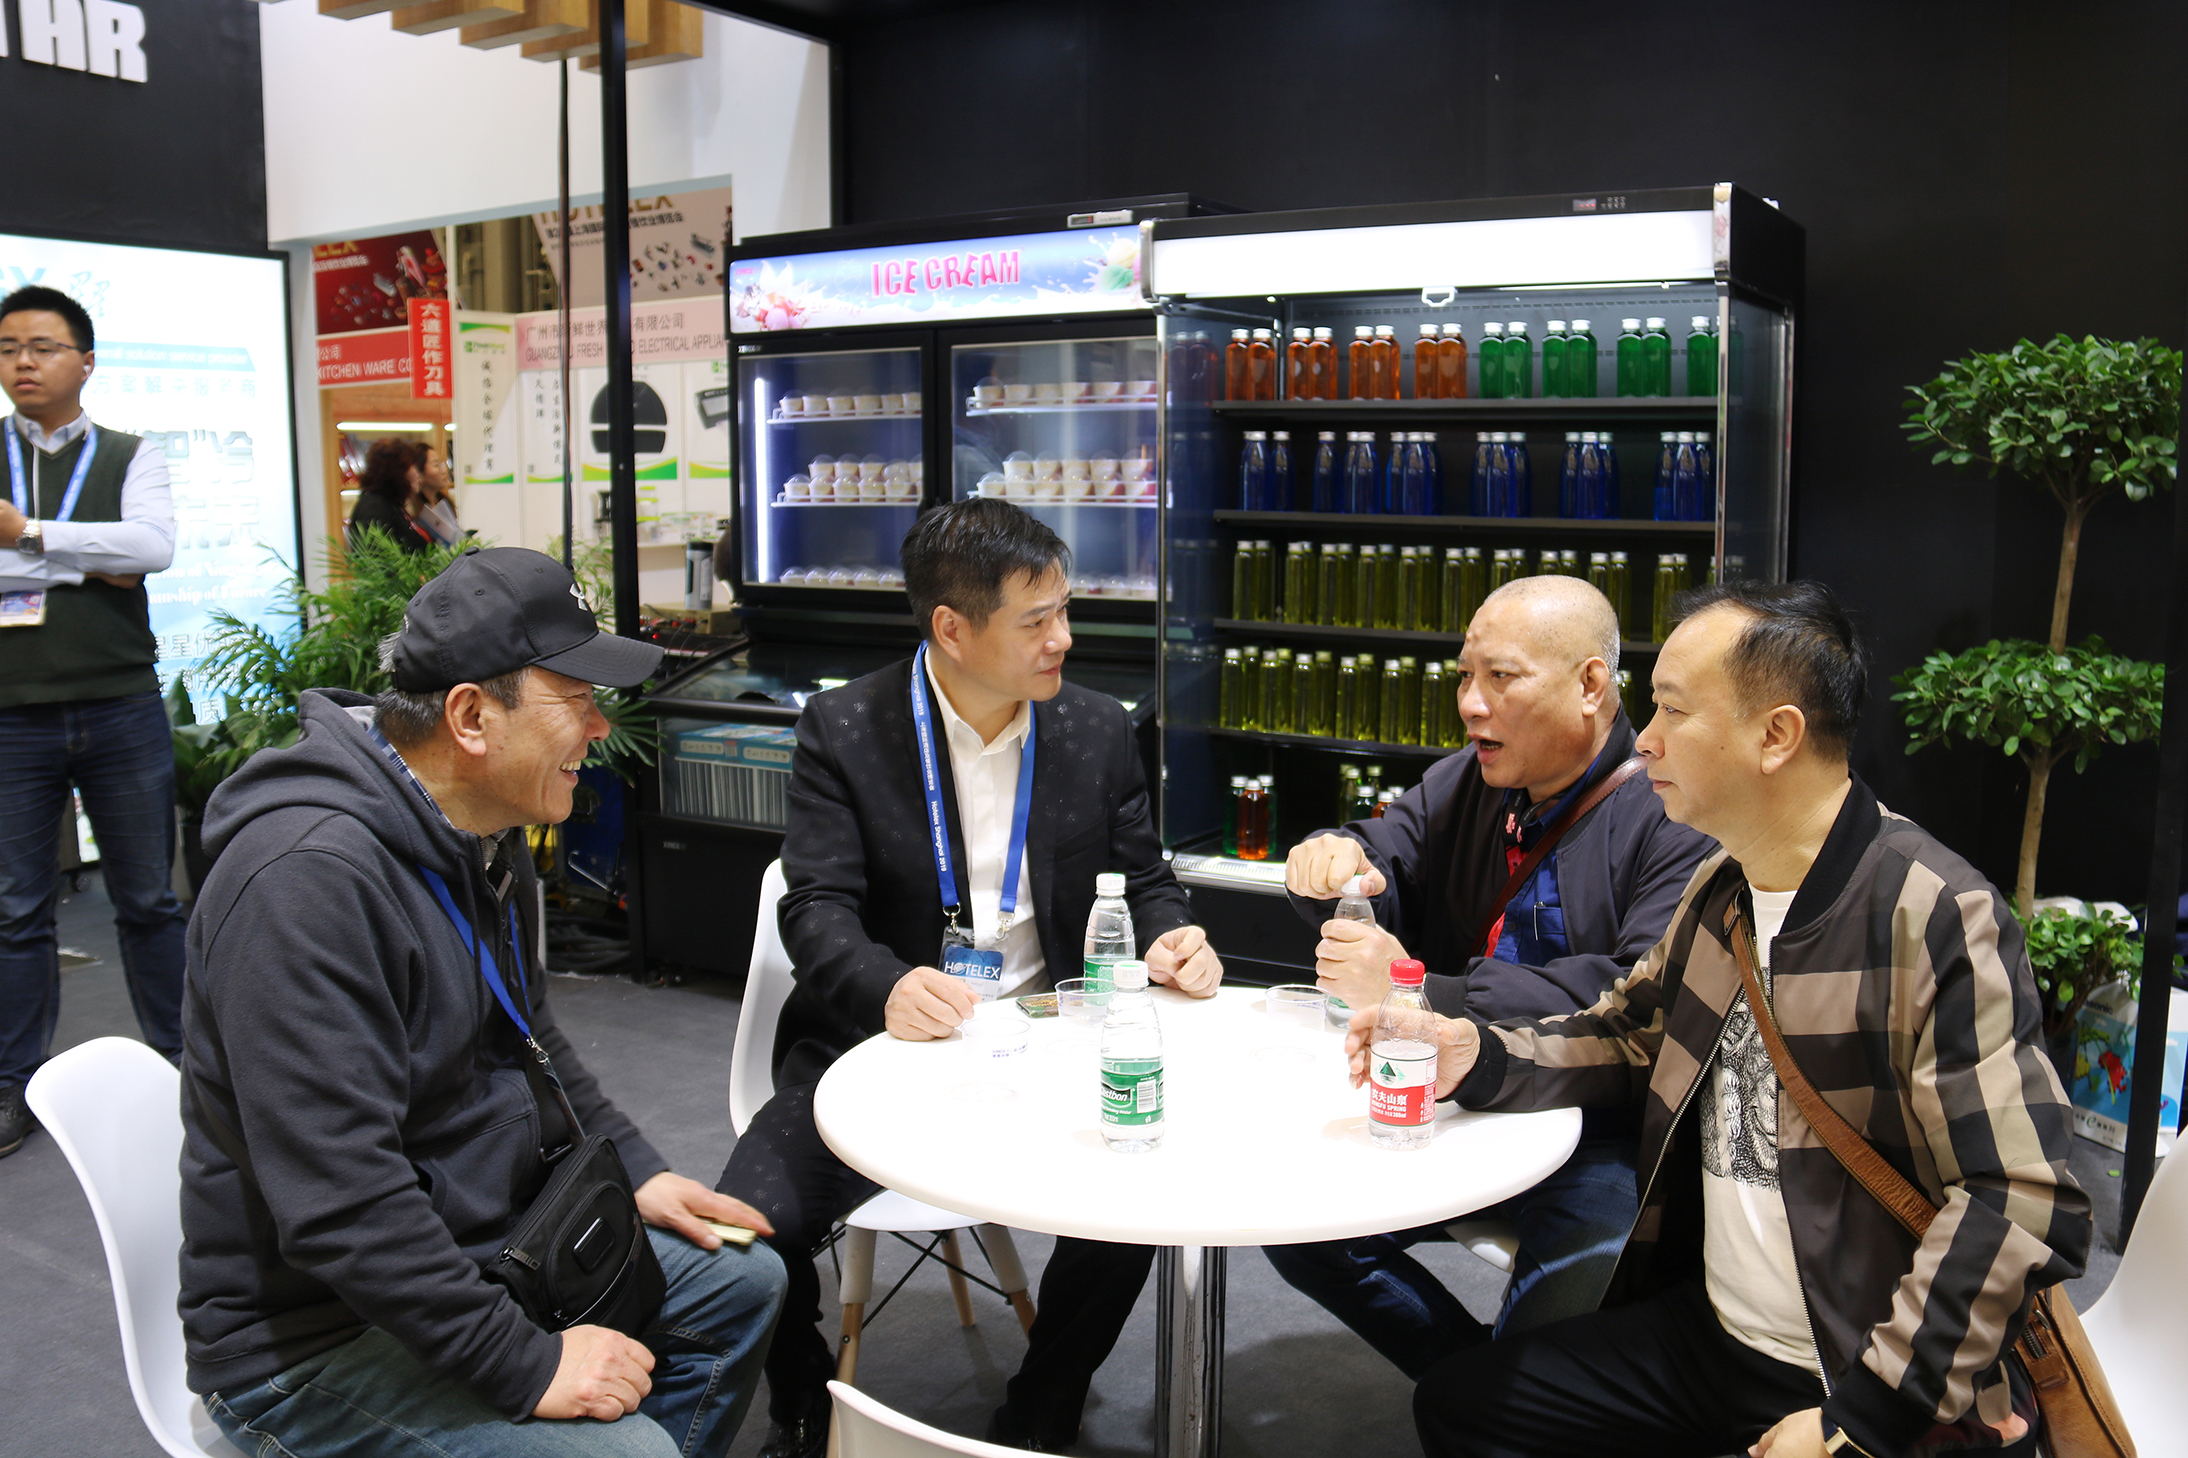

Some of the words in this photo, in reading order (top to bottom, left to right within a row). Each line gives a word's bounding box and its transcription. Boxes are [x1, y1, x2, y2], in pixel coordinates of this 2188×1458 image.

[872, 259, 917, 296] ICE
[923, 250, 1020, 289] CREAM
[577, 343, 603, 359] FRESH
[638, 336, 689, 353] ELECTRICAL
[363, 357, 395, 375] WARE
[944, 961, 1001, 979] HOTELEX
[1371, 1088, 1409, 1106] 农夫山泉
